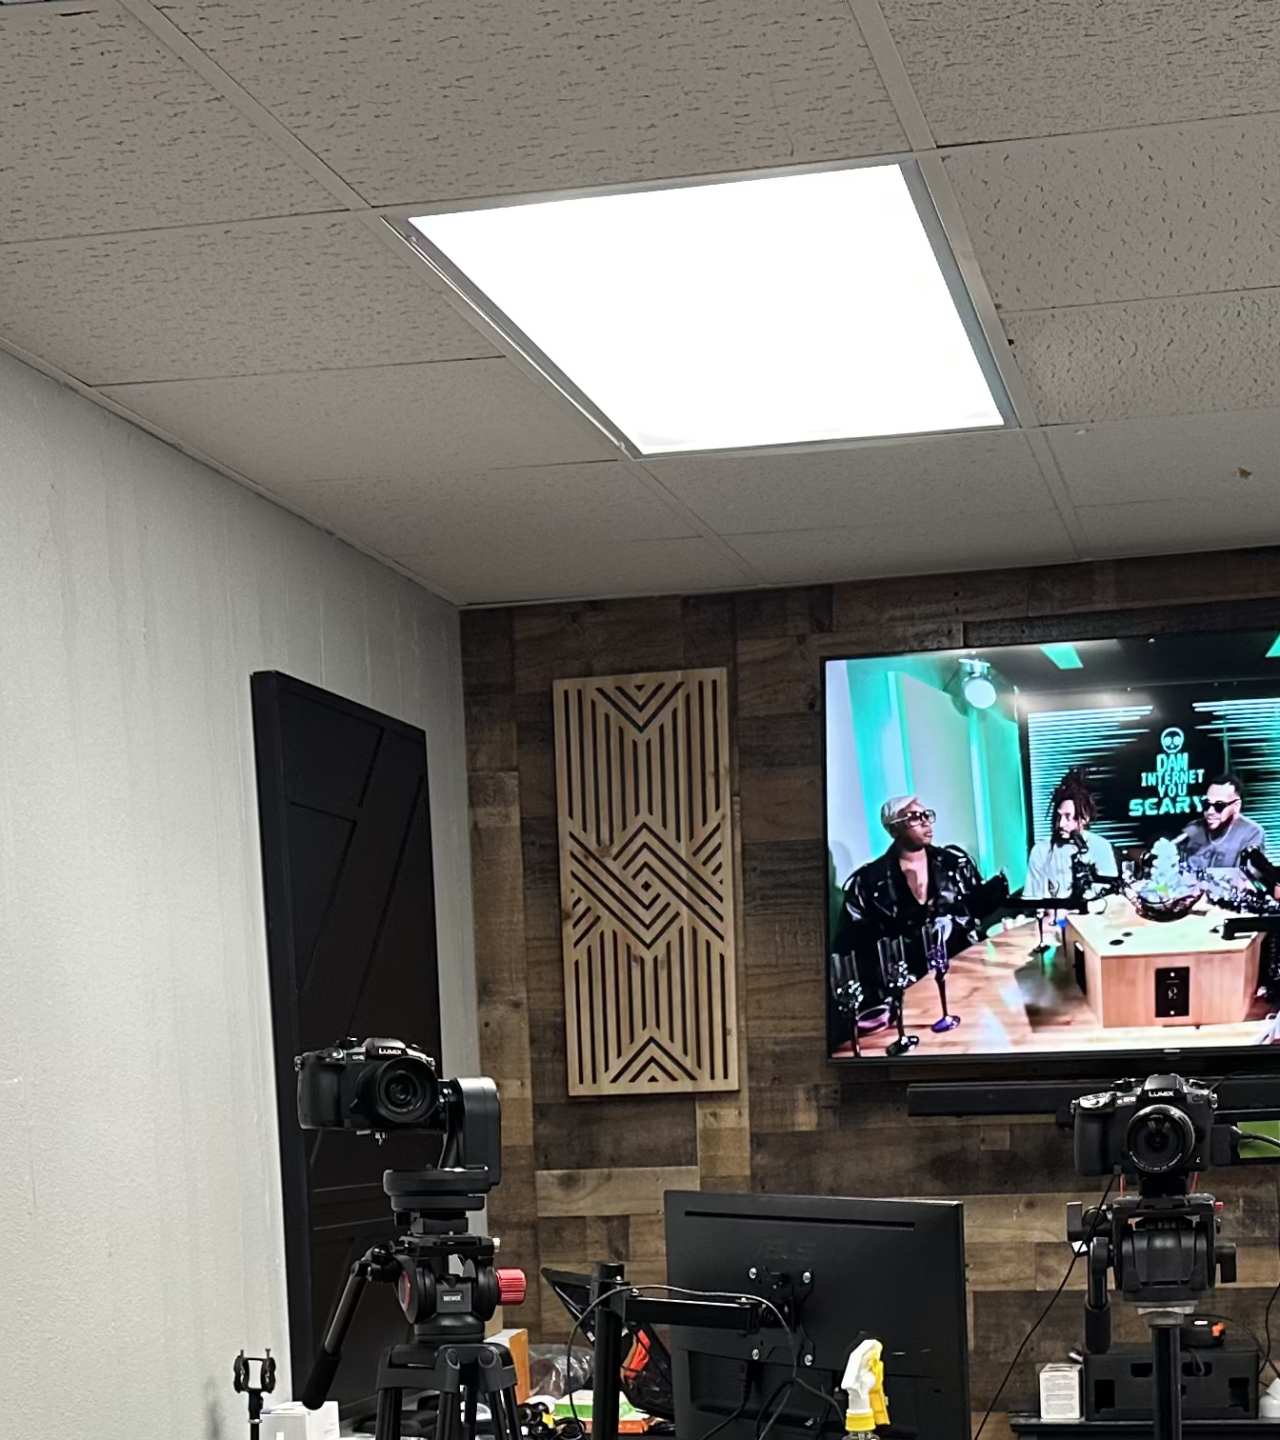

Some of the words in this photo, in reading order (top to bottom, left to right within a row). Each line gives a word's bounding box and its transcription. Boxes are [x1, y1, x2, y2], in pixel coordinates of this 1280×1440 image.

[1156, 752, 1189, 772] DAM
[1140, 768, 1205, 787] INTERNET
[1157, 784, 1187, 798] YOU
